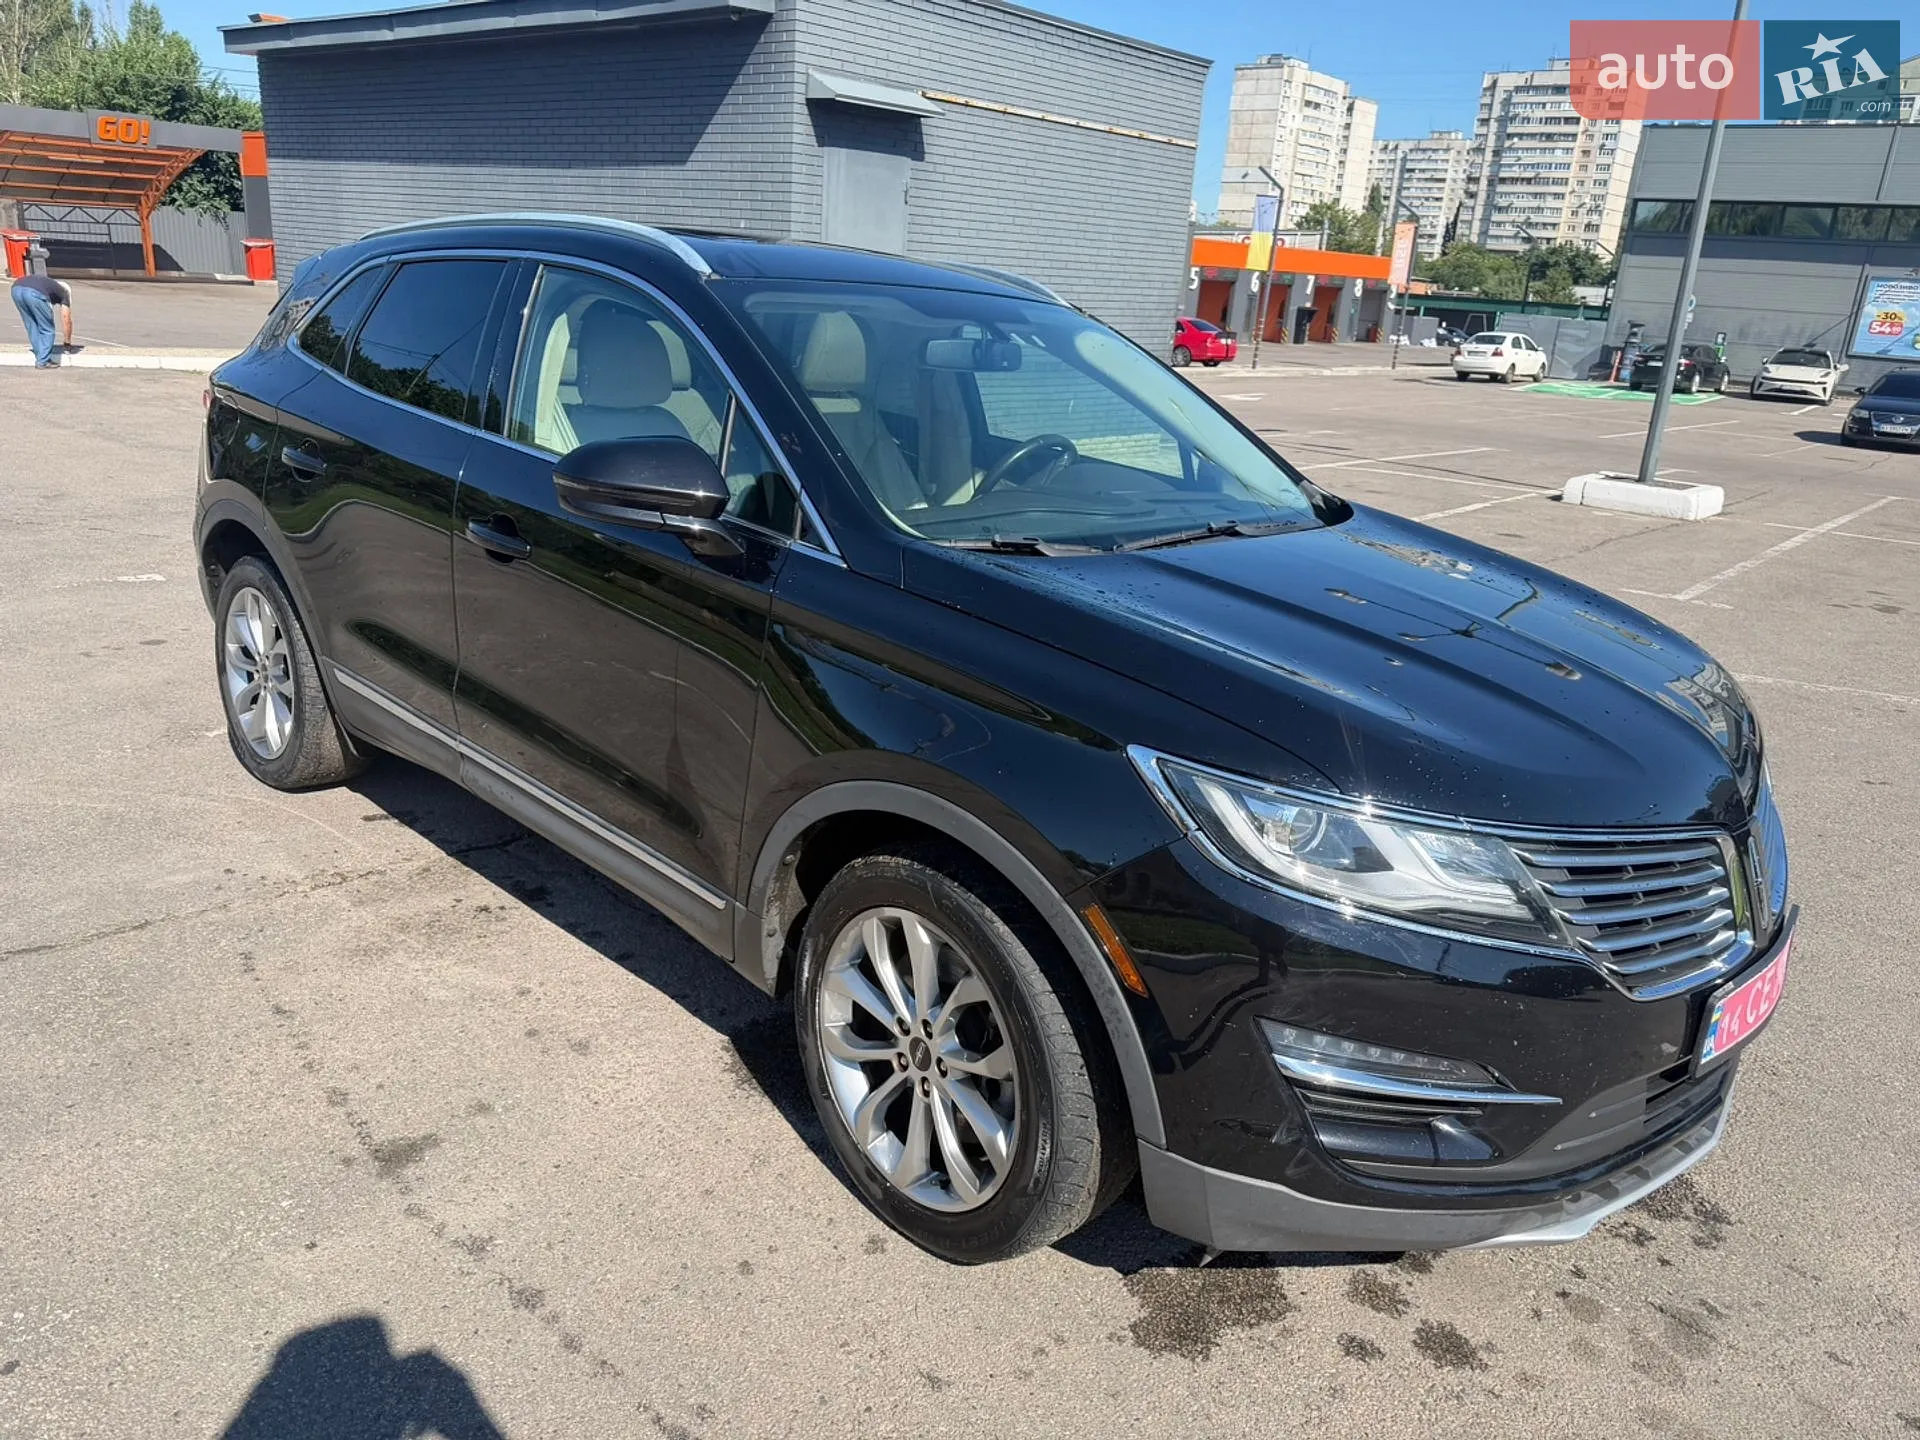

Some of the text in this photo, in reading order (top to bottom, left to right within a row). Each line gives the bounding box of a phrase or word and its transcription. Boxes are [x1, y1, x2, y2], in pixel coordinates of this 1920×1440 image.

[97, 116, 150, 145] GO!
[1188, 267, 1200, 290] 5
[1250, 271, 1260, 293] 6
[1305, 275, 1316, 295] 7
[1354, 278, 1364, 297] 8
